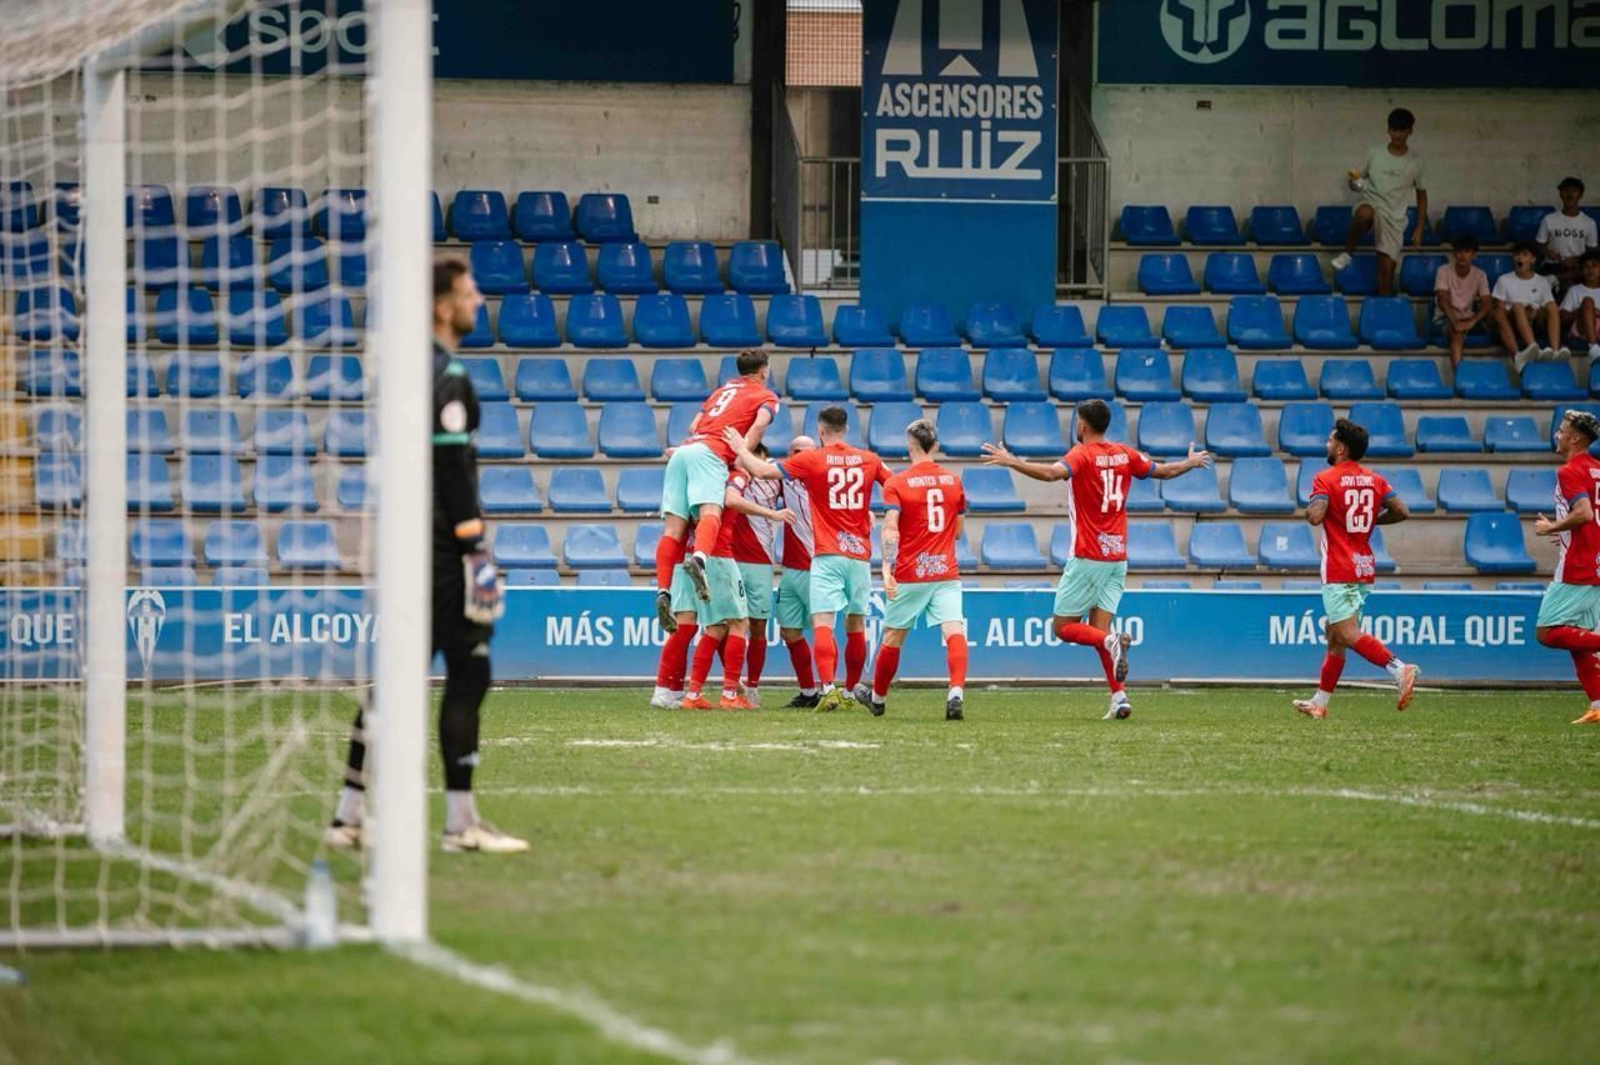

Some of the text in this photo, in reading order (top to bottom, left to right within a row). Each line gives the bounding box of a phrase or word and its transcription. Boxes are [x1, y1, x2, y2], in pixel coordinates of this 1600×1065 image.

[250, 9, 439, 67] spo
[876, 83, 1043, 119] ASCENSORES
[708, 388, 738, 417] 9
[827, 467, 864, 510] 22
[1100, 468, 1124, 513] 14
[926, 488, 946, 533] 6
[1344, 489, 1375, 533] 23
[11, 613, 75, 647] QUE
[224, 613, 380, 643] EL ALCOY
[546, 610, 614, 646] MÁS
[1464, 615, 1526, 647] QUE
